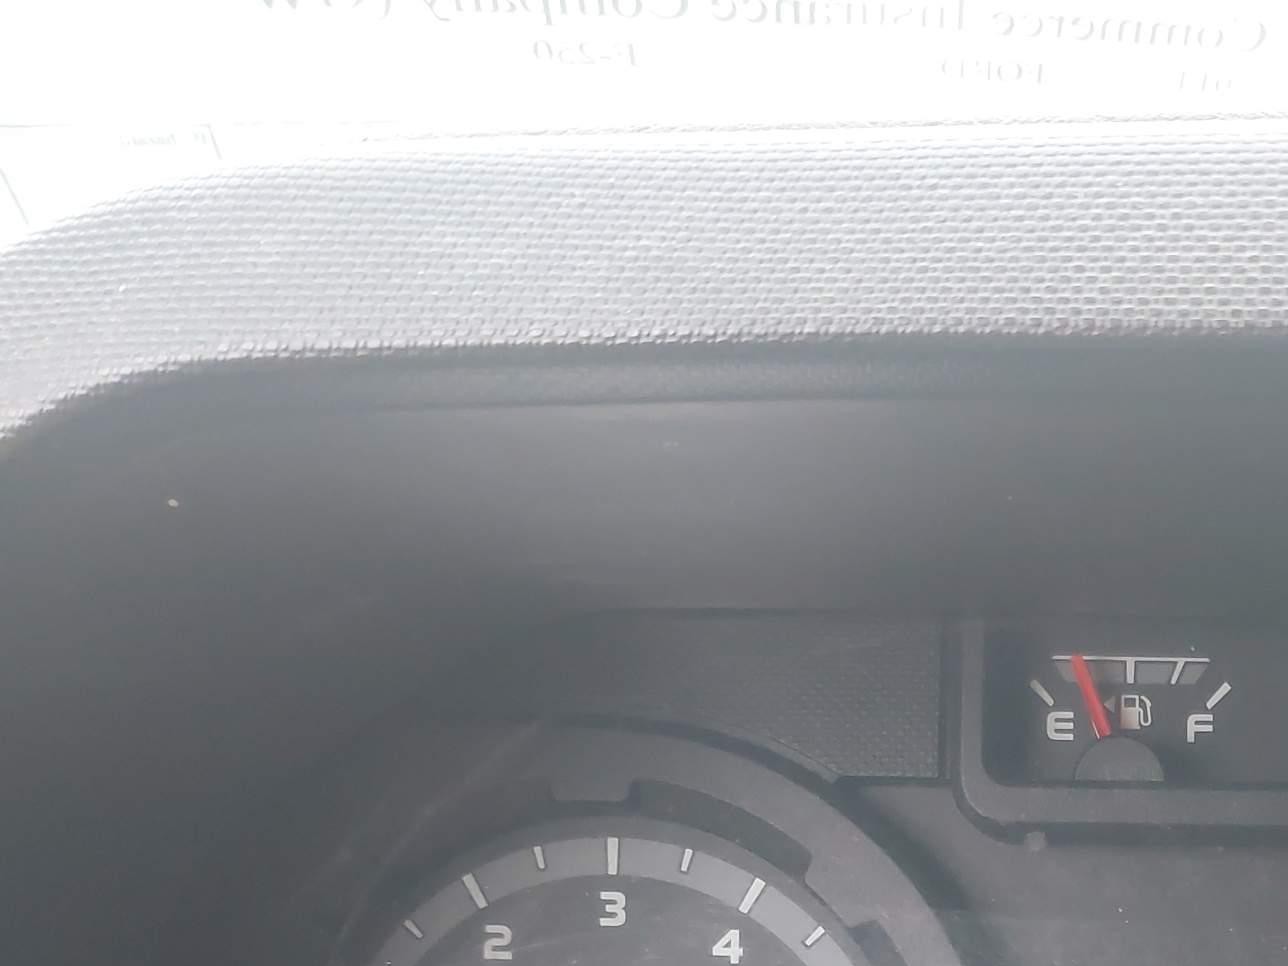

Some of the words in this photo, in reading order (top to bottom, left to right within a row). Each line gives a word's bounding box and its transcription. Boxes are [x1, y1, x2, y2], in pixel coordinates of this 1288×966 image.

[1046, 711, 1075, 741] E
[1186, 713, 1214, 743] F
[599, 891, 627, 927] 3
[483, 924, 513, 960] 2
[712, 929, 744, 964] 4
